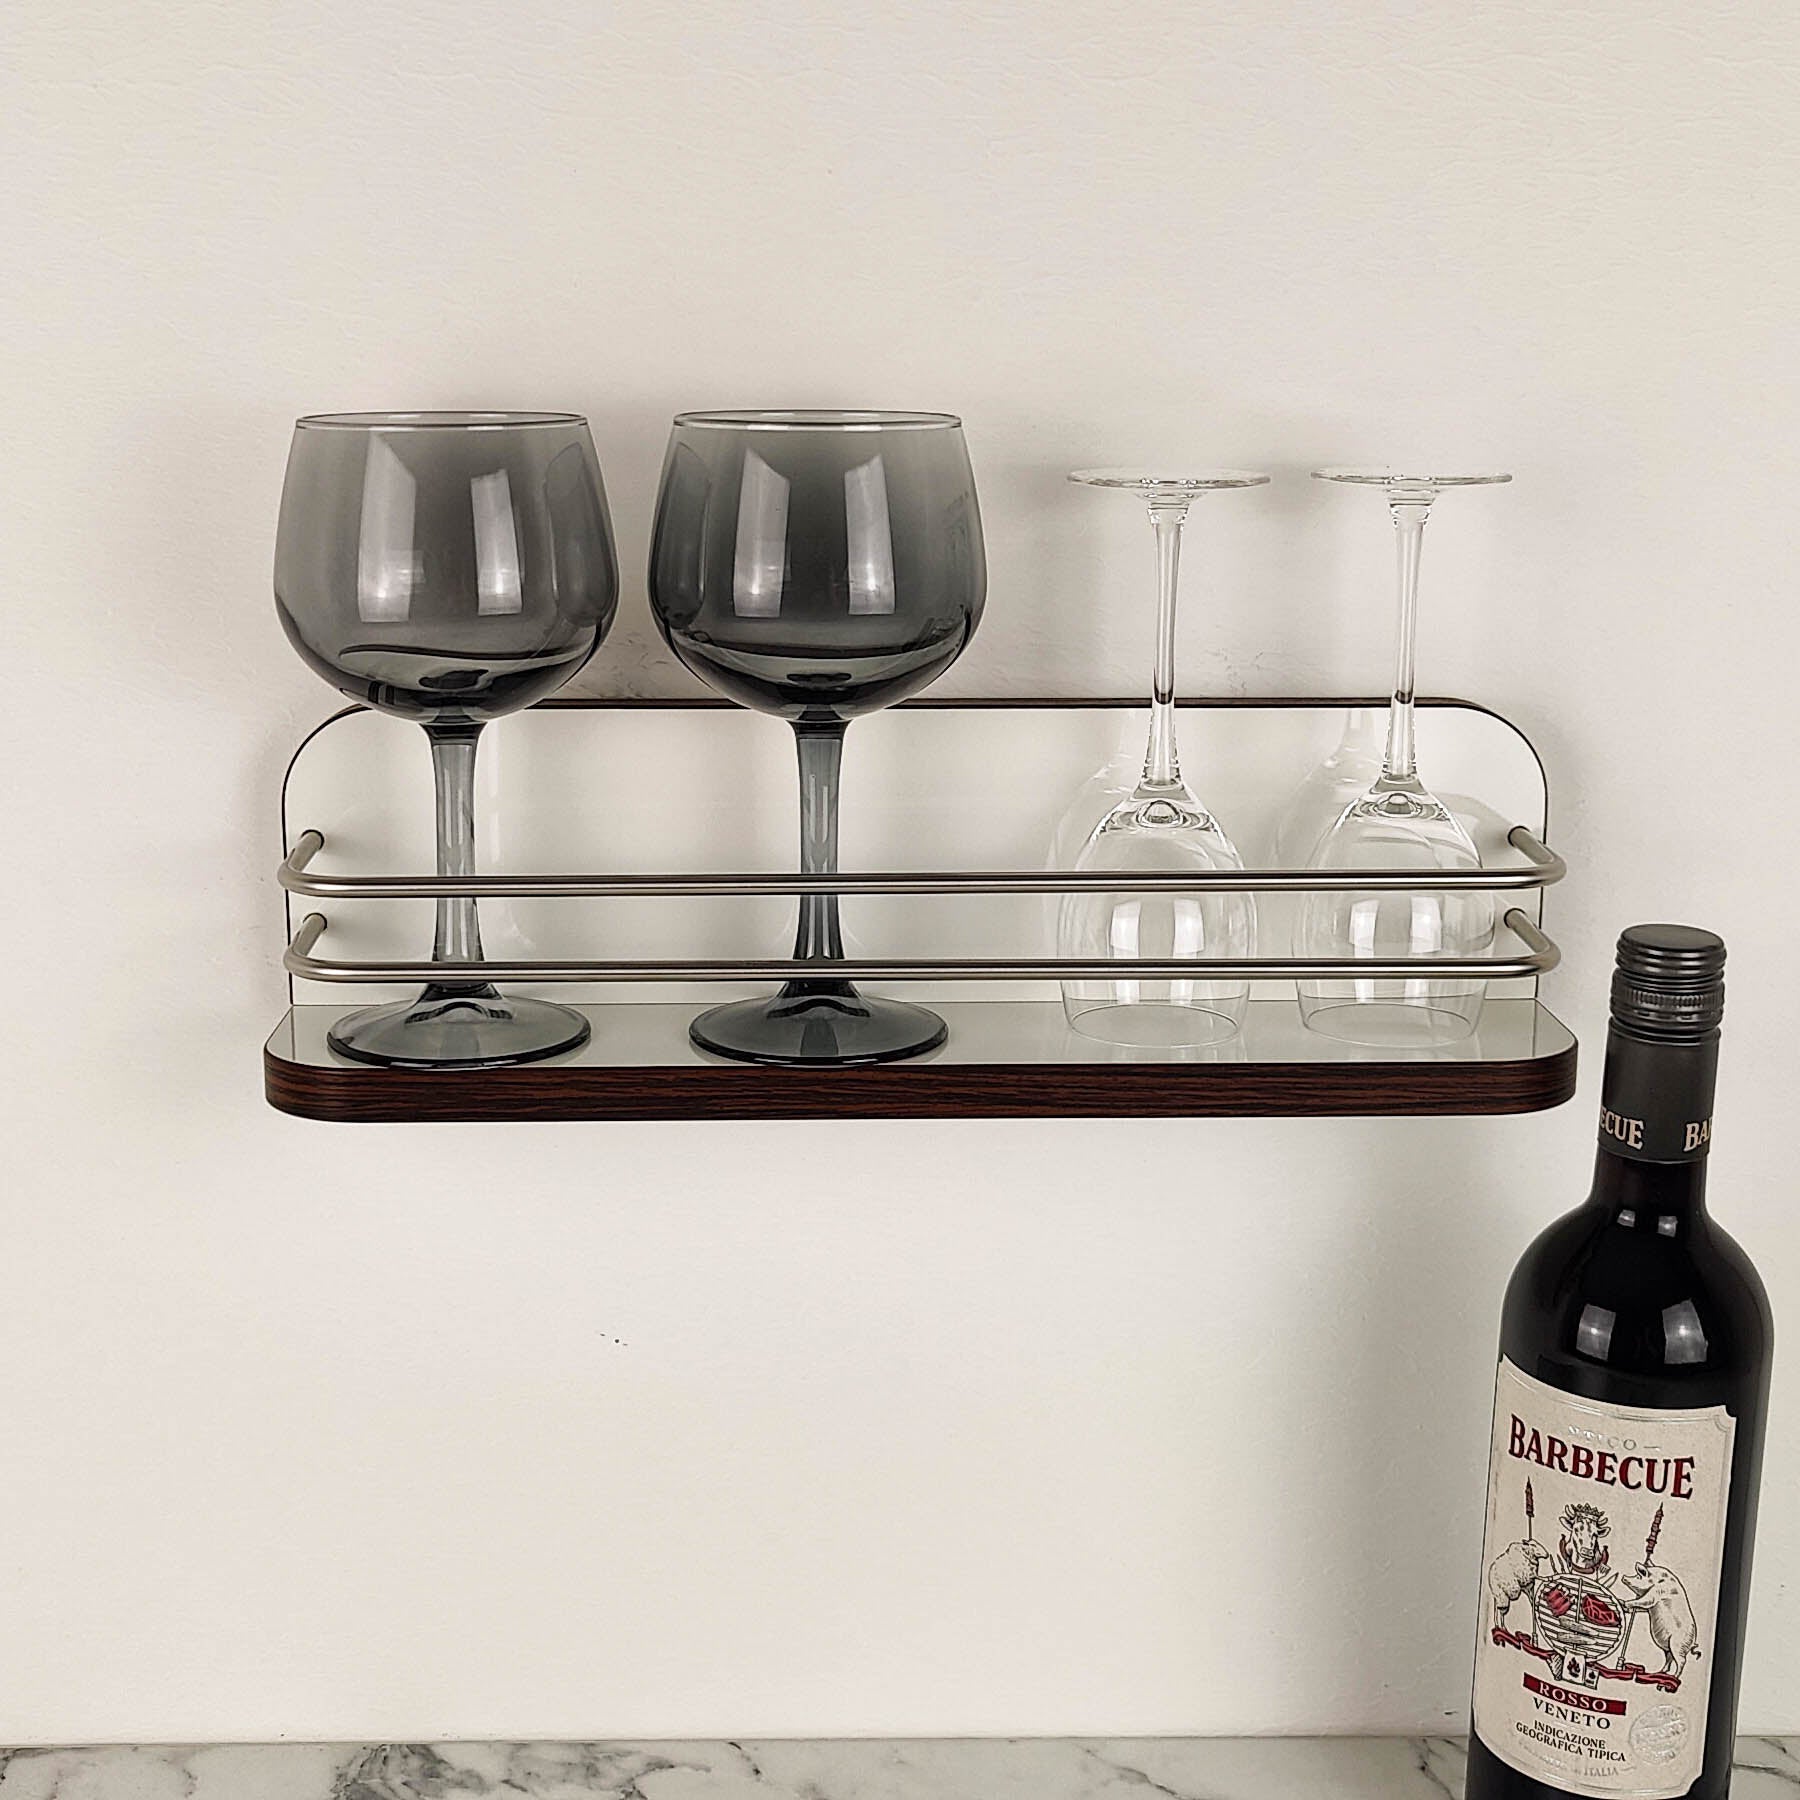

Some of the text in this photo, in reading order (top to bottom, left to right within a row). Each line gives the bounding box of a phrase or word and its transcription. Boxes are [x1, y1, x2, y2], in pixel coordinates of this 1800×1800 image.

[1508, 1414, 1695, 1500] BARBECUE
[1533, 1697, 1611, 1729] VENETO
[1539, 1682, 1607, 1712] ROSSO
[1516, 1721, 1583, 1756] GEOGRAFICA
[1587, 1747, 1626, 1762] TIPICA
[1534, 1720, 1606, 1750] INDICAZIONE
